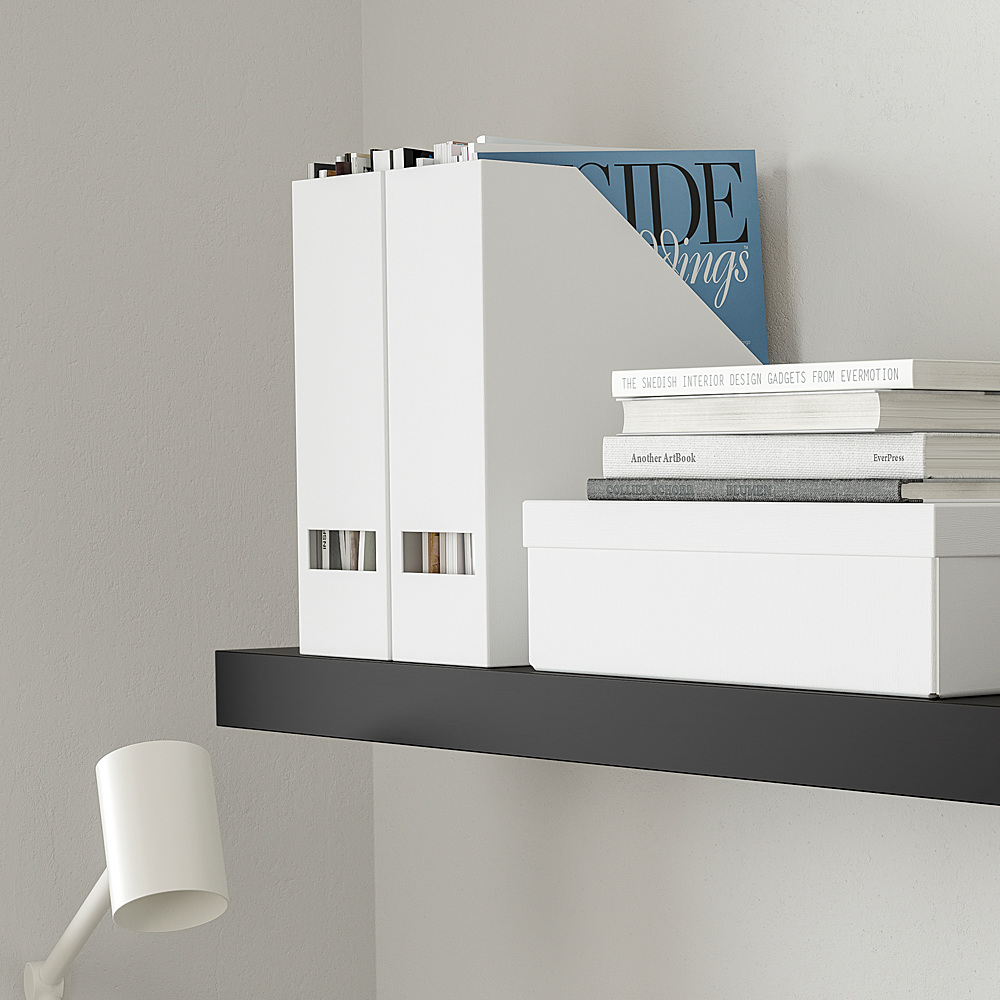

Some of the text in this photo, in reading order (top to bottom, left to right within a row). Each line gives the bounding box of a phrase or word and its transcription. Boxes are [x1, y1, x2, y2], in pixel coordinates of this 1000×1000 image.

[622, 367, 899, 389] THE SWEDISH INTERIOR DESIGN GADGETS FROM EVERMOTION
[630, 453, 696, 463] Another ArtBook
[873, 453, 905, 462] EverPress
[726, 485, 773, 496] BLUMEN
